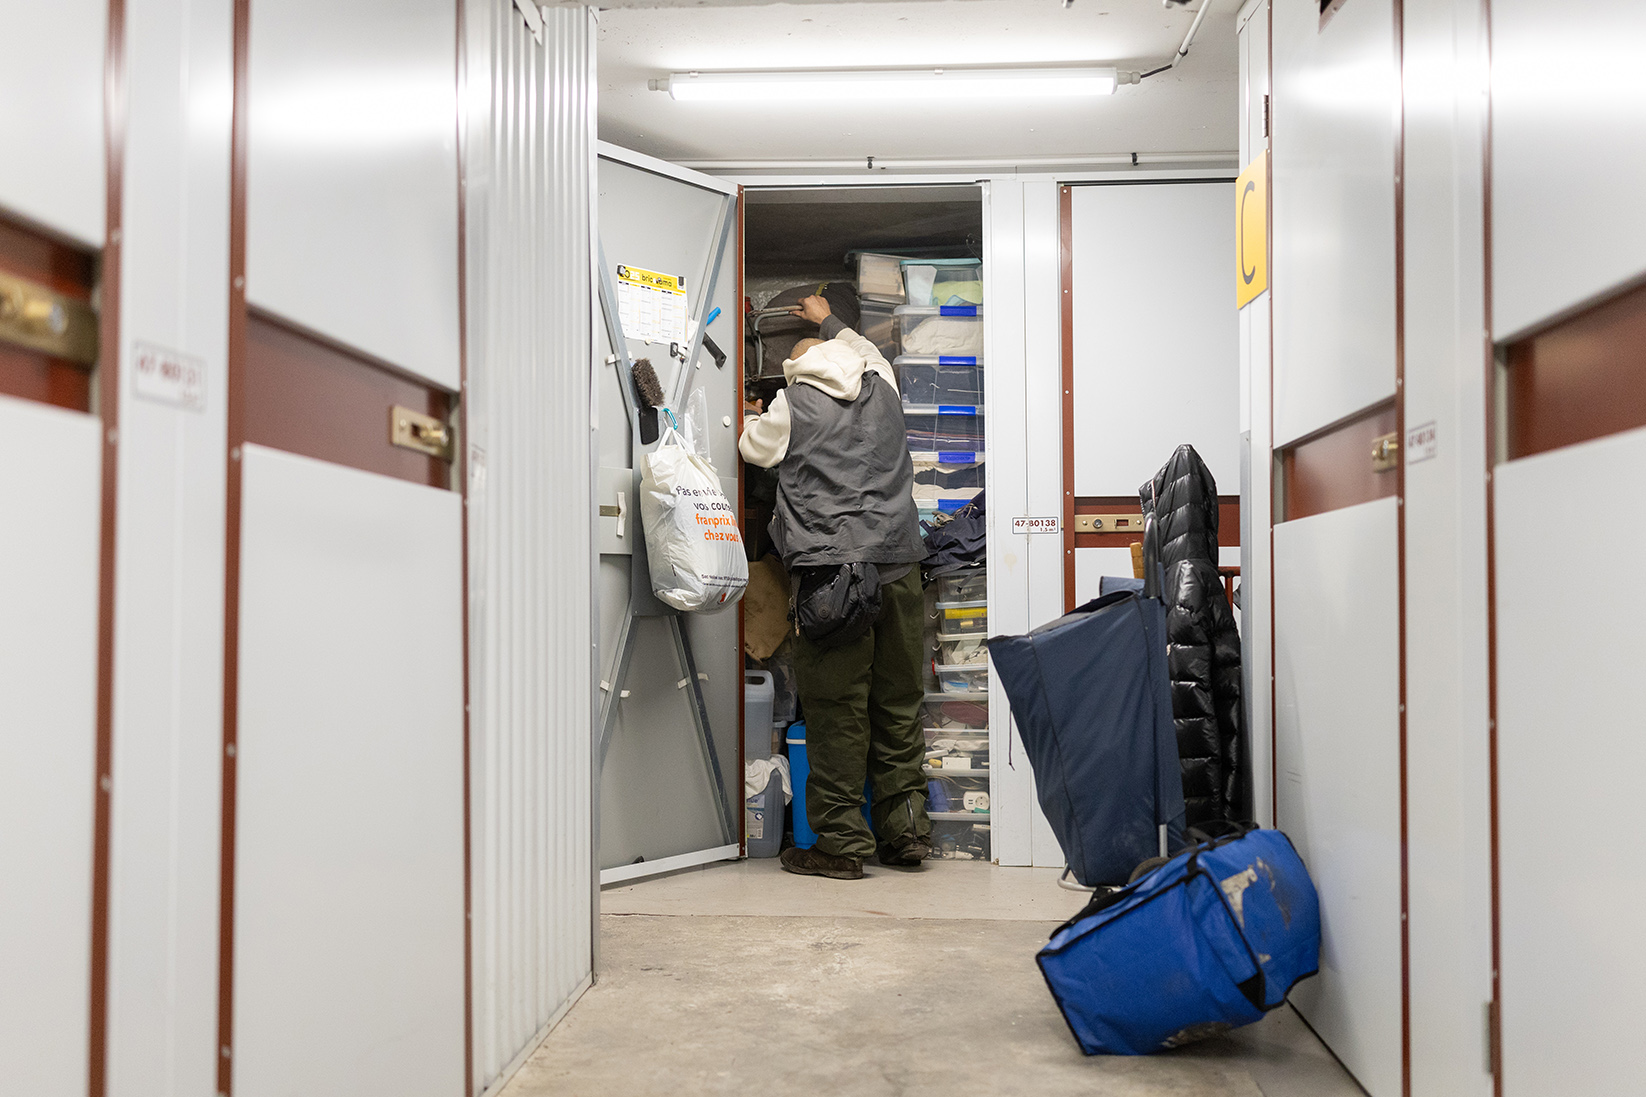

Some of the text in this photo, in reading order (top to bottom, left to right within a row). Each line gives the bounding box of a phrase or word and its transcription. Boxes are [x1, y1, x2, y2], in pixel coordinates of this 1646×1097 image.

[1241, 180, 1256, 285] C
[676, 485, 692, 496] Pas
[693, 503, 709, 511] vos
[695, 513, 730, 529] franprix
[704, 529, 724, 541] chez
